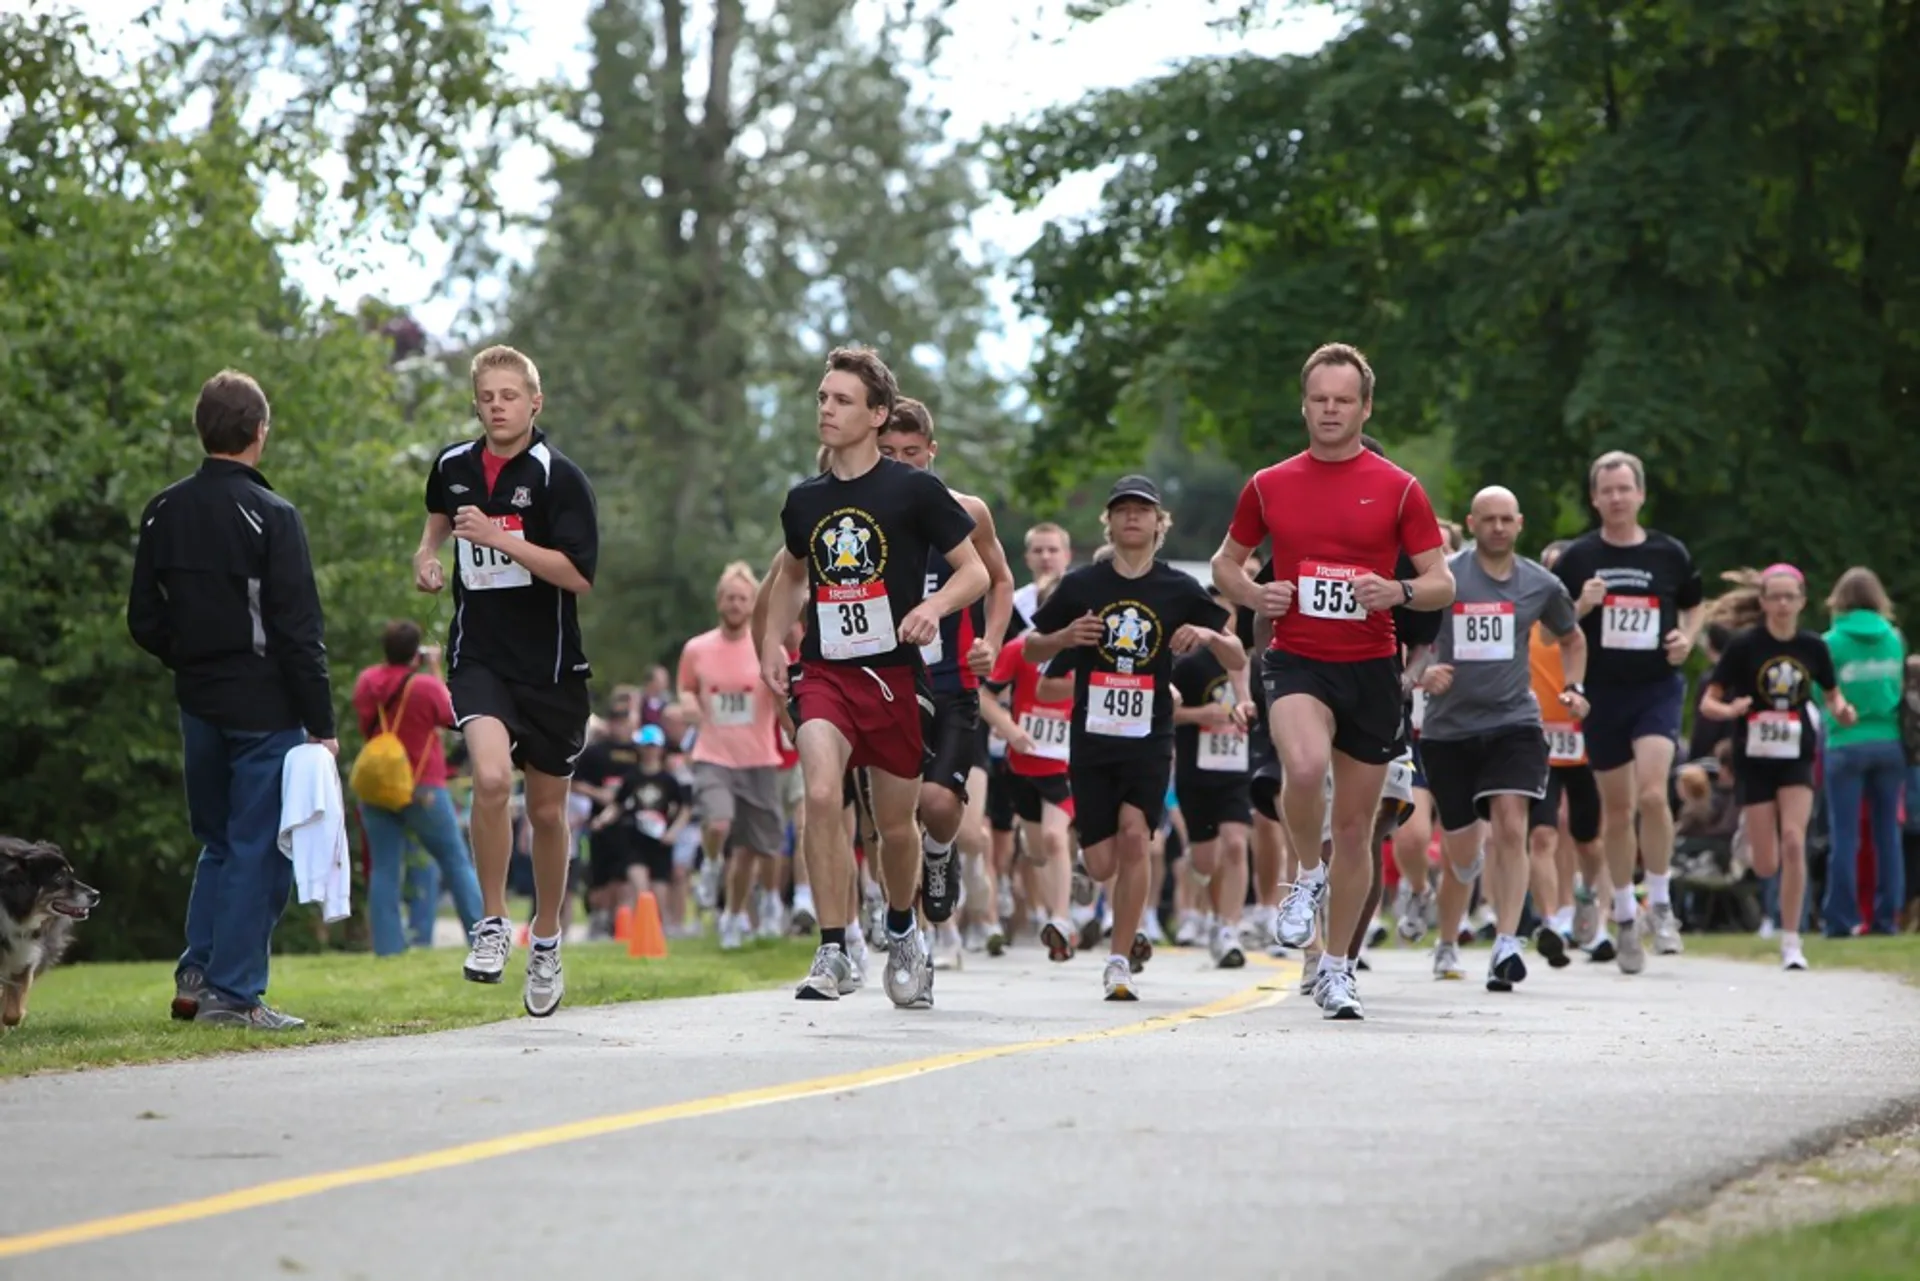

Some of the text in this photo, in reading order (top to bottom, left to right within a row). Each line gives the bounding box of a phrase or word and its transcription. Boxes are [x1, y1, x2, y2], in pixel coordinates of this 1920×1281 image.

[1313, 580, 1357, 614] 553
[839, 604, 868, 636] 38
[1467, 616, 1502, 642] 850
[1608, 608, 1651, 632] 1227
[1103, 689, 1143, 717] 498
[1025, 717, 1066, 744] 1013
